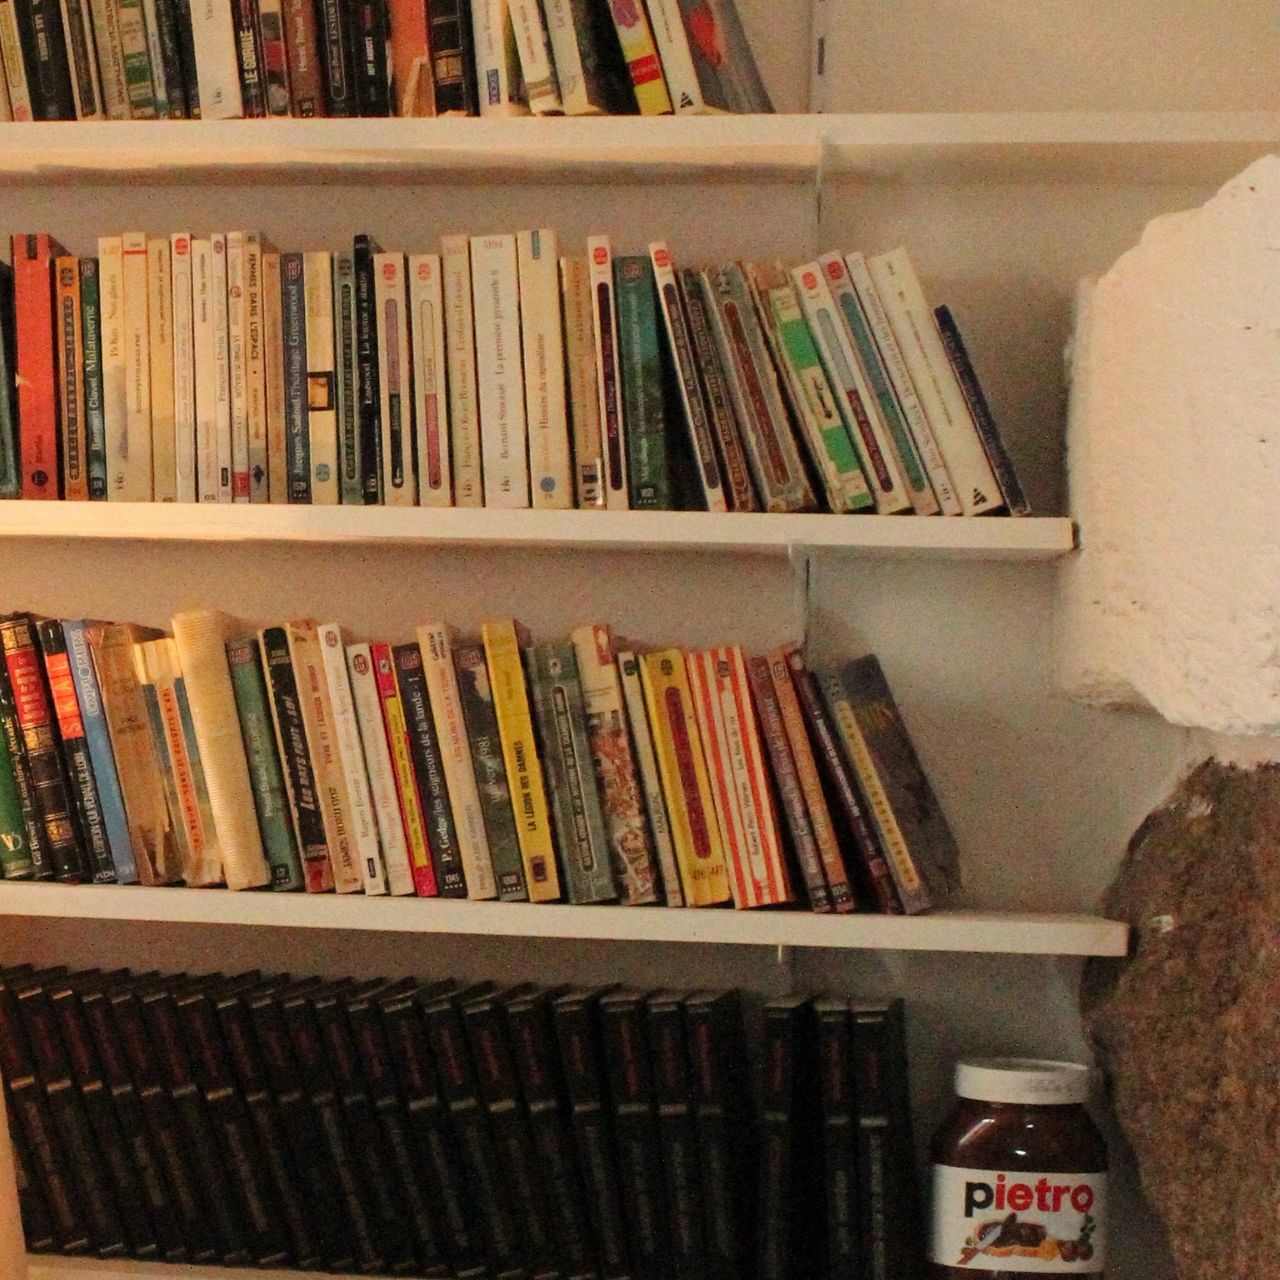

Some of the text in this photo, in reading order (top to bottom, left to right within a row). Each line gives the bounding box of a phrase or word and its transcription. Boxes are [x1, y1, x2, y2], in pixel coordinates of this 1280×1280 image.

[245, 70, 258, 83] LE
[85, 305, 97, 371] Malataverne
[89, 378, 99, 407] Clavel
[288, 285, 304, 476] Jacques Greenwood
[539, 395, 549, 429] Histoire
[53, 662, 80, 733] SKAL
[412, 692, 424, 719] lande
[420, 734, 430, 746] de
[478, 736, 492, 759] 1981
[424, 749, 442, 796] seigneurs
[519, 775, 529, 789] DES
[84, 810, 98, 822] QUI
[341, 838, 354, 868] JAMES
[440, 851, 452, 862] P.
[964, 1173, 1094, 1218] pietro
